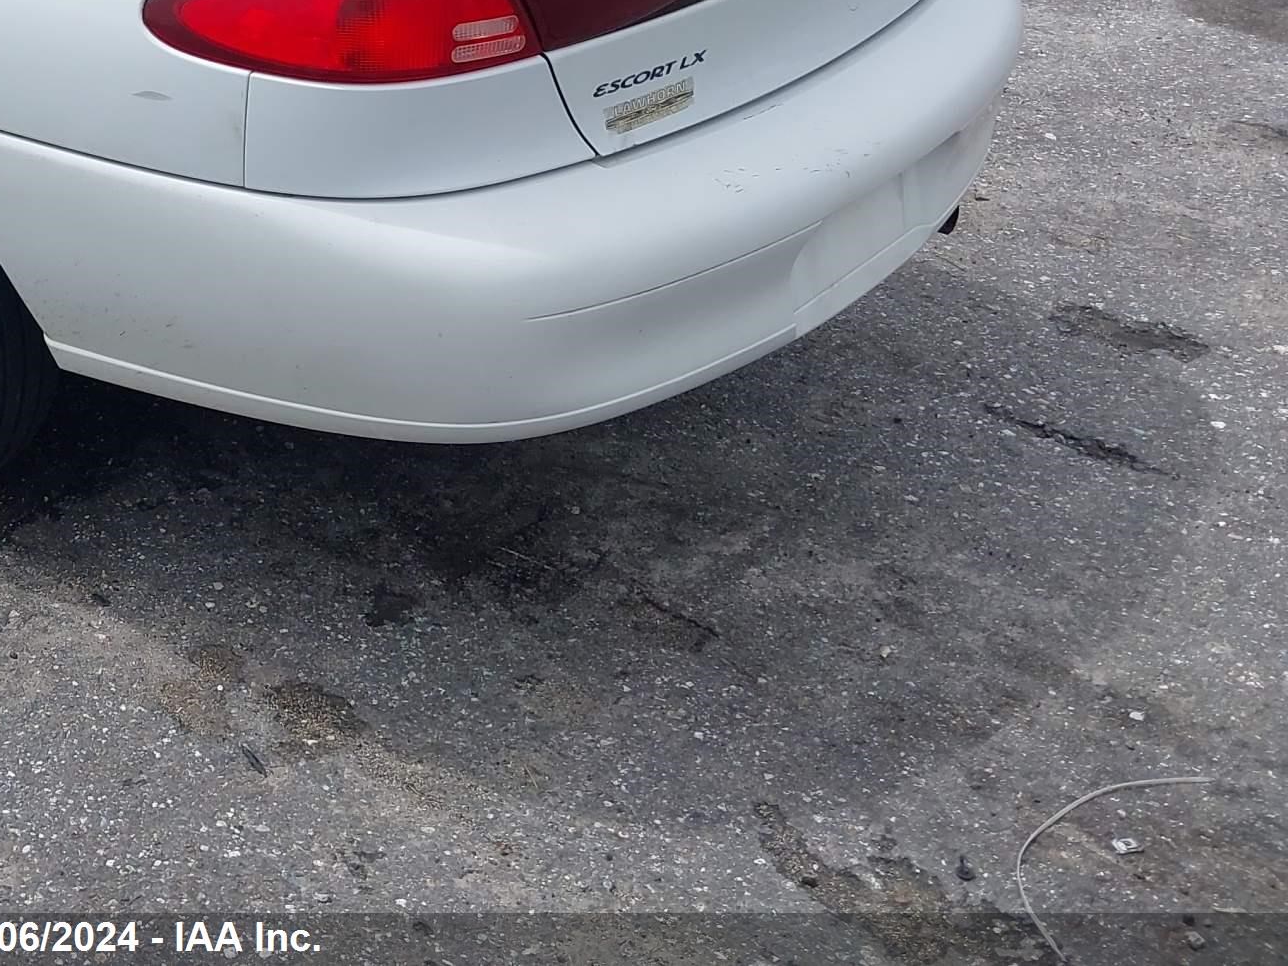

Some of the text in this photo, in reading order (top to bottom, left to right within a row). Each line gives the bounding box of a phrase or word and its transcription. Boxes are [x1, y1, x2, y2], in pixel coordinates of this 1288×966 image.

[592, 49, 707, 98] ESCORT LX
[613, 80, 687, 117] LAWHORN
